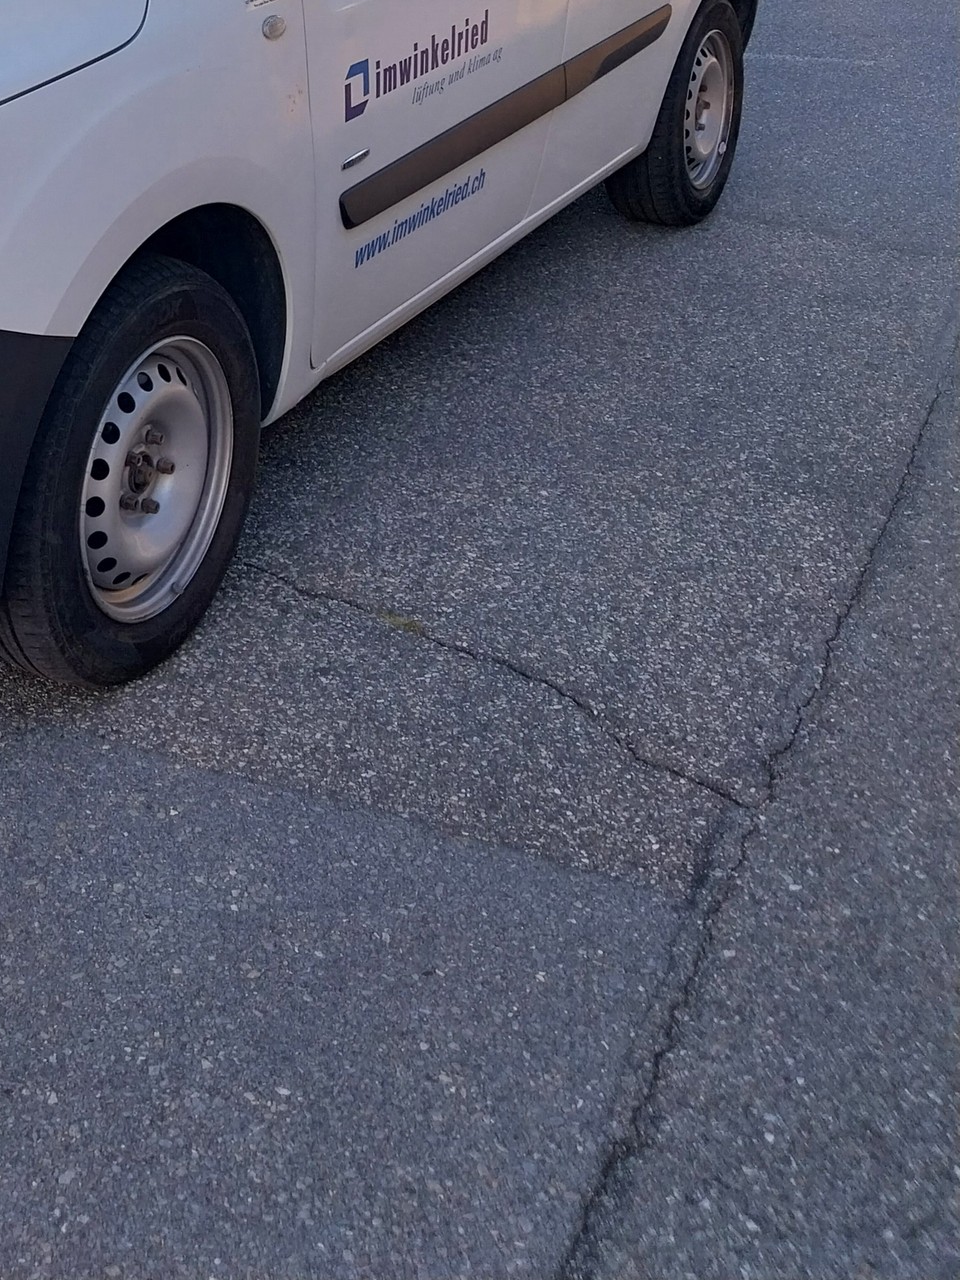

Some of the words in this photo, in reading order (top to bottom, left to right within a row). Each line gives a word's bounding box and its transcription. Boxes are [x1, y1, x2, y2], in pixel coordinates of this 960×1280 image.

[376, 9, 489, 99] imwinkelried
[412, 78, 445, 106] lüftung
[448, 61, 465, 87] und
[467, 51, 491, 75] klima
[492, 46, 503, 63] ag
[354, 168, 486, 269] www.imwinkelried.ch
